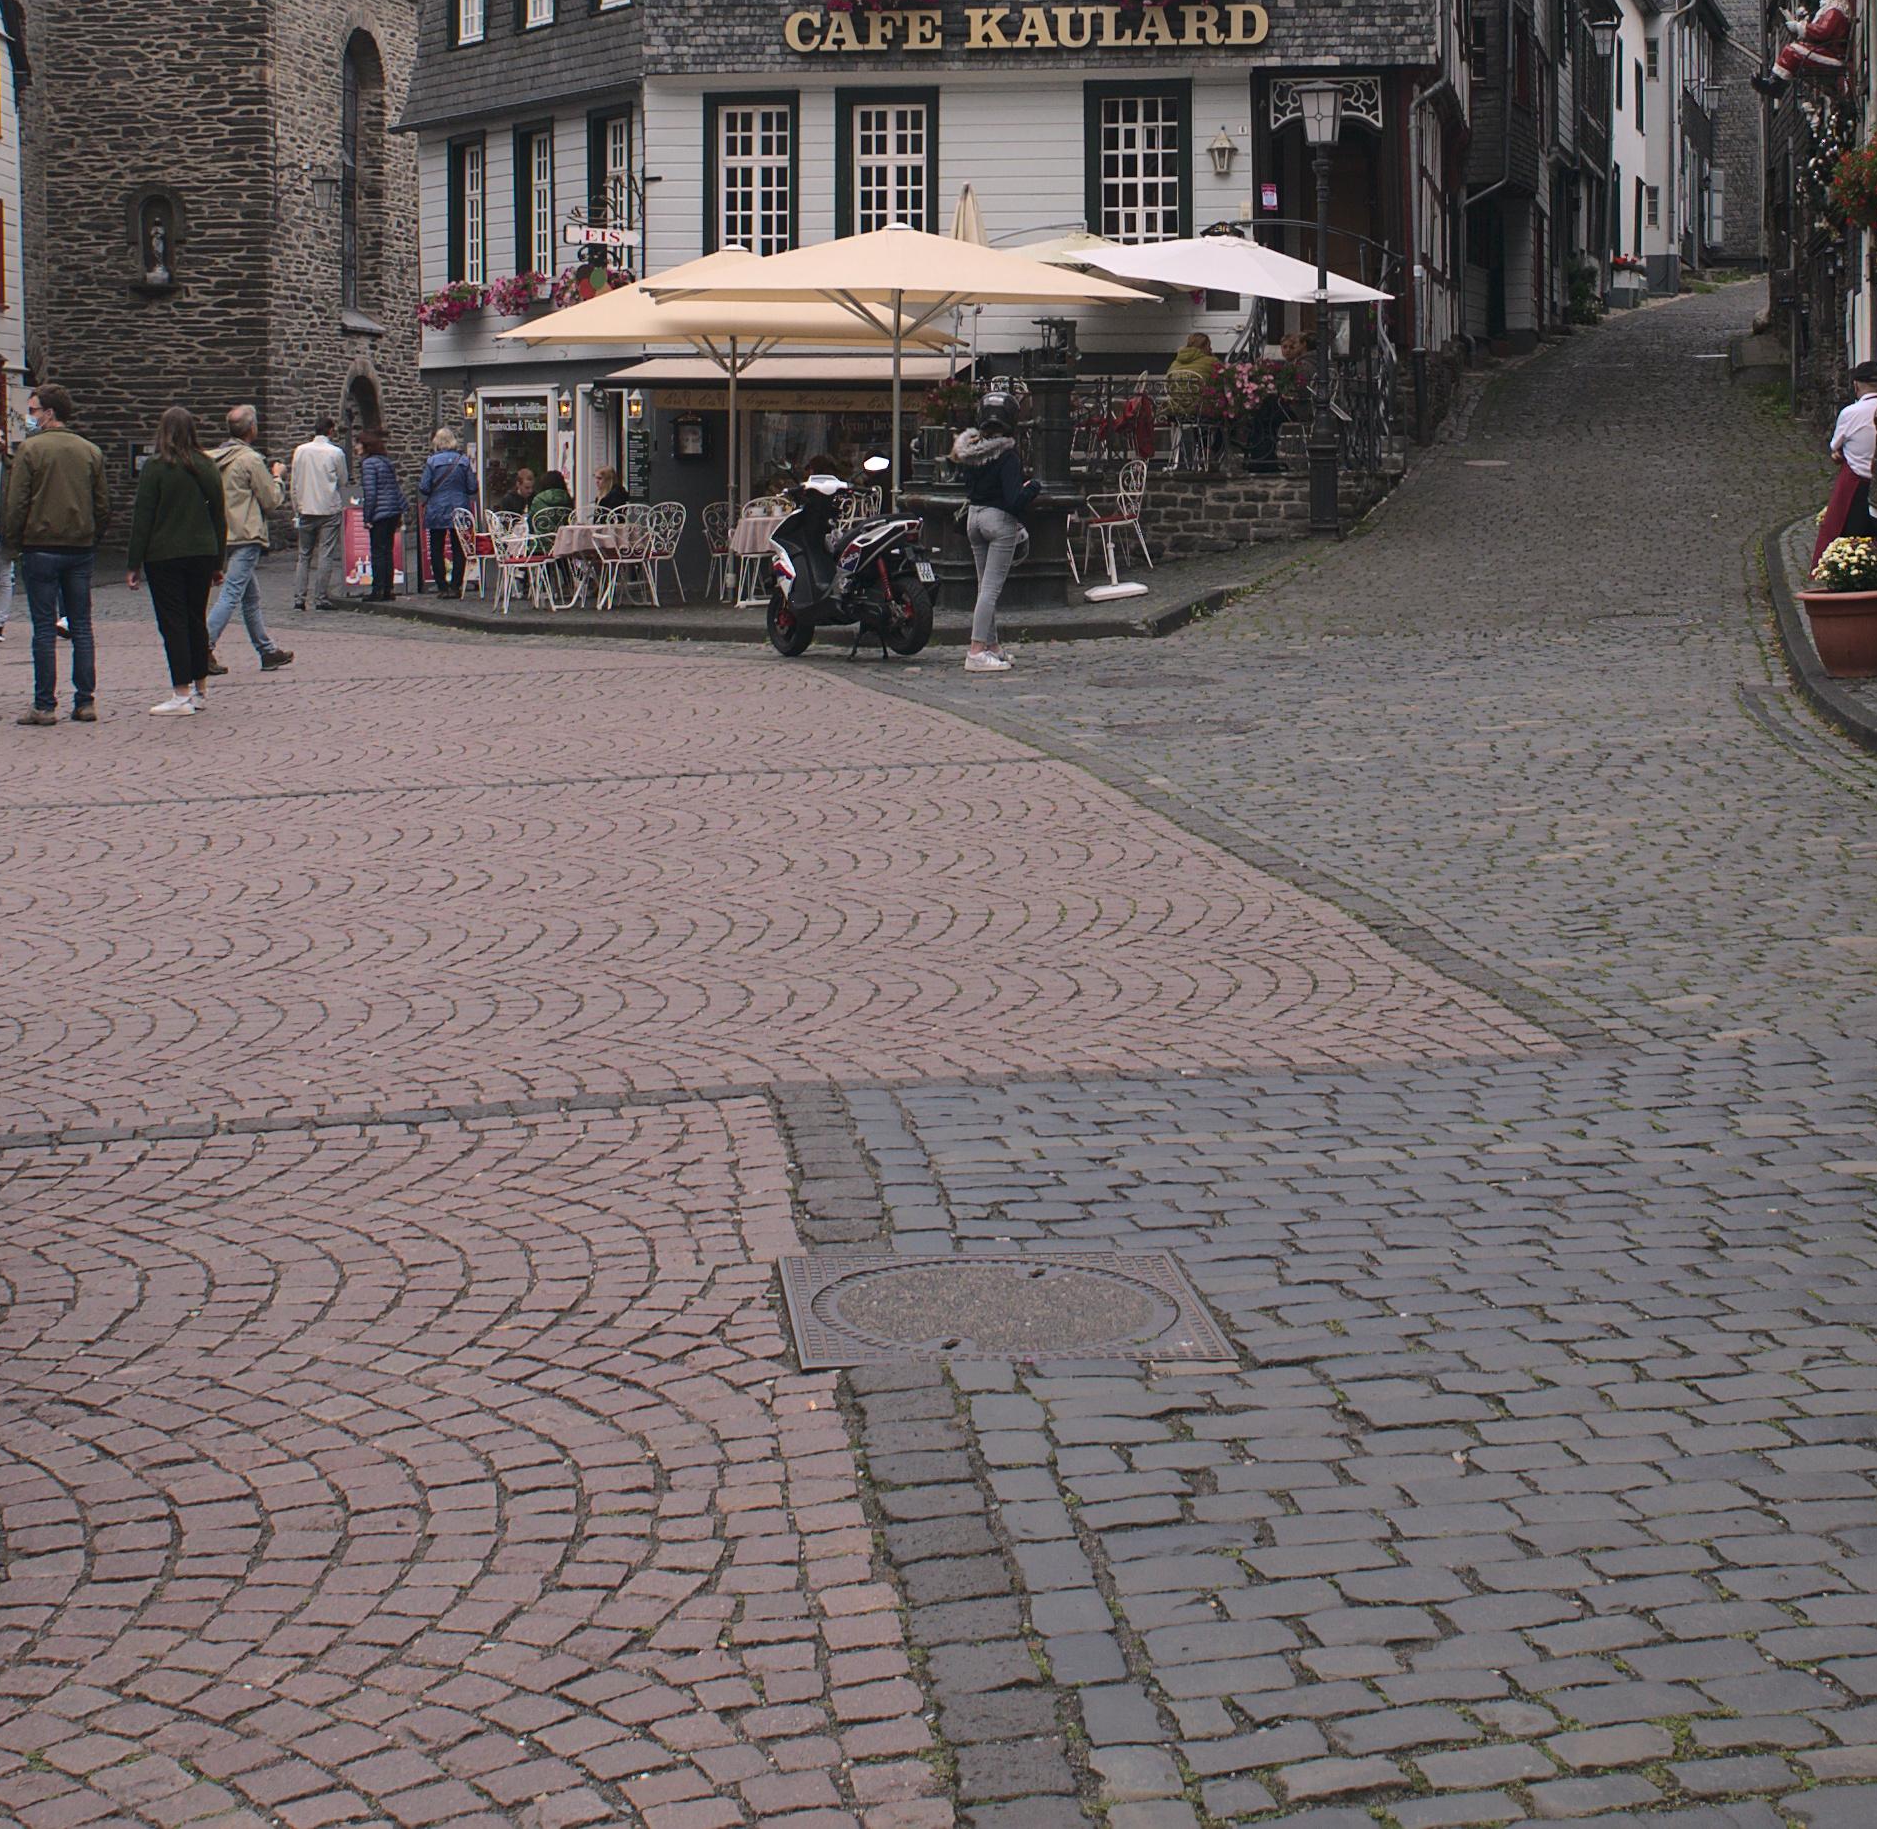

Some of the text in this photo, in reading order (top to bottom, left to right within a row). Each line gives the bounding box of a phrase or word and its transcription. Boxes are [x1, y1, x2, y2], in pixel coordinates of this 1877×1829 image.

[783, 3, 1270, 53] CAFE KAULARD
[585, 229, 621, 243] EIS
